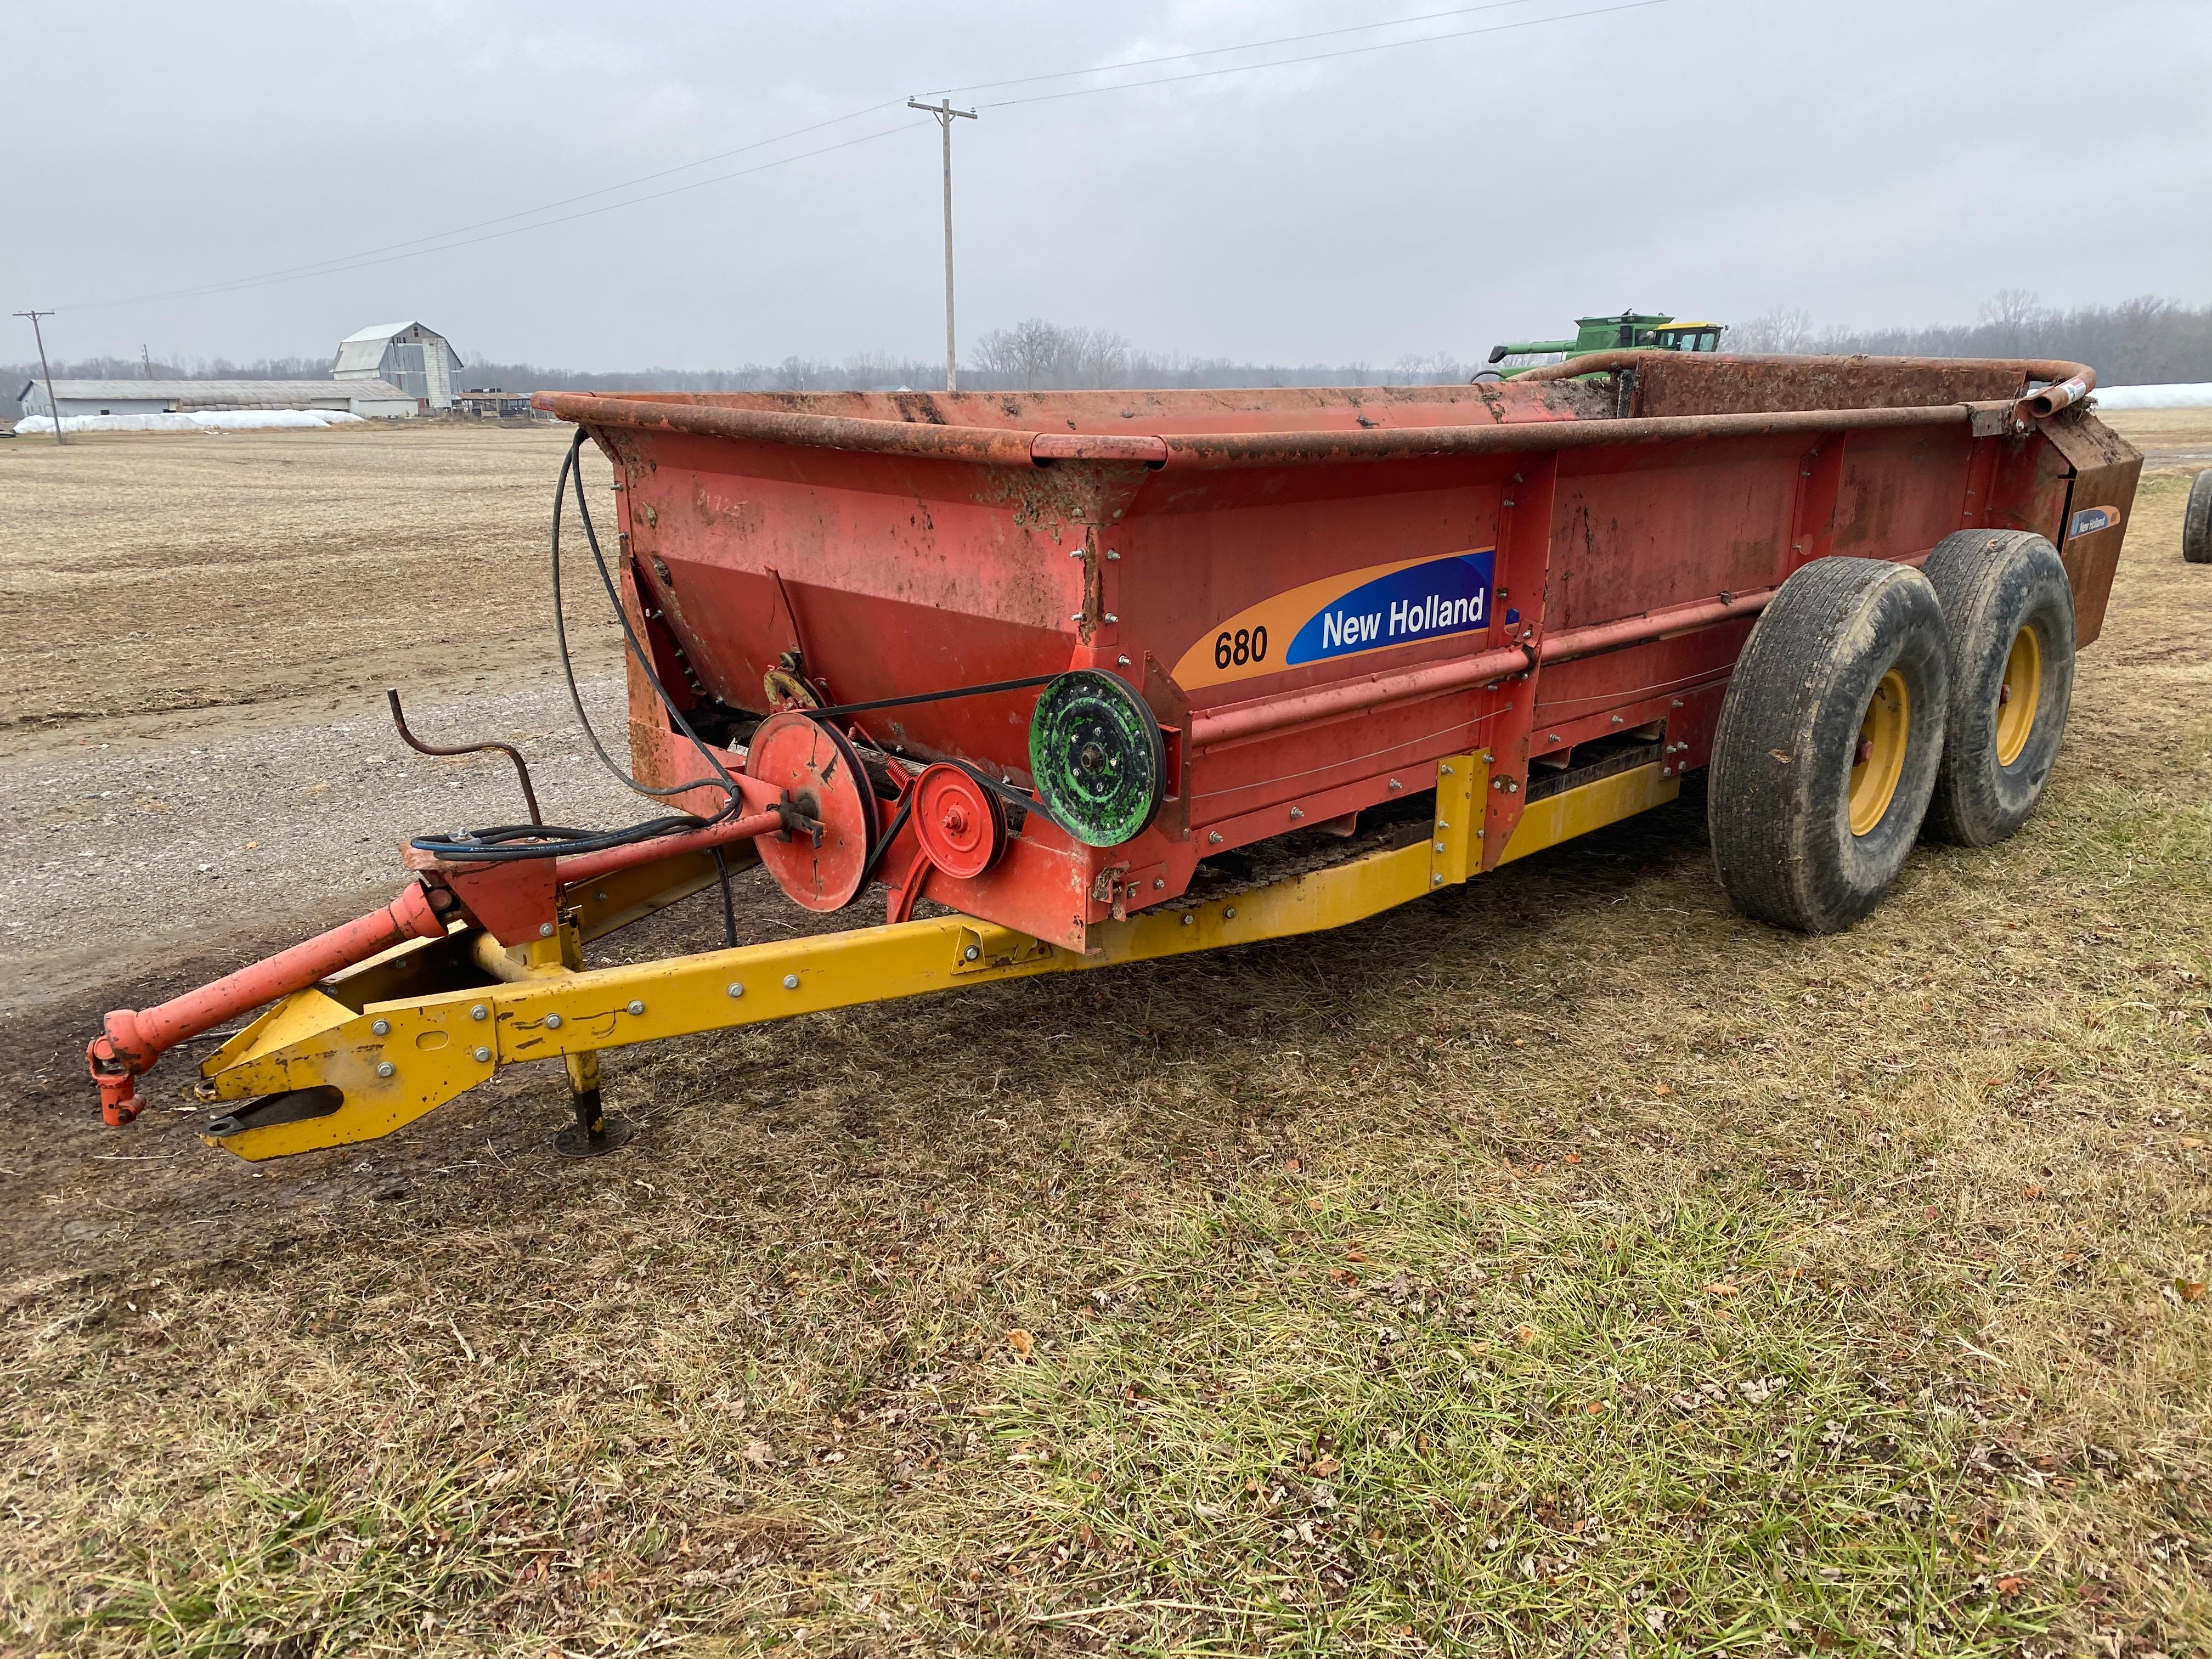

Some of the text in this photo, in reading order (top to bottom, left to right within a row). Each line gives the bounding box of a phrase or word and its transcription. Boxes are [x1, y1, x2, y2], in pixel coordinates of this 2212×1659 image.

[2079, 515, 2106, 533] New Holland
[1323, 588, 1485, 649] New Holland
[1215, 625, 1268, 669] 680
